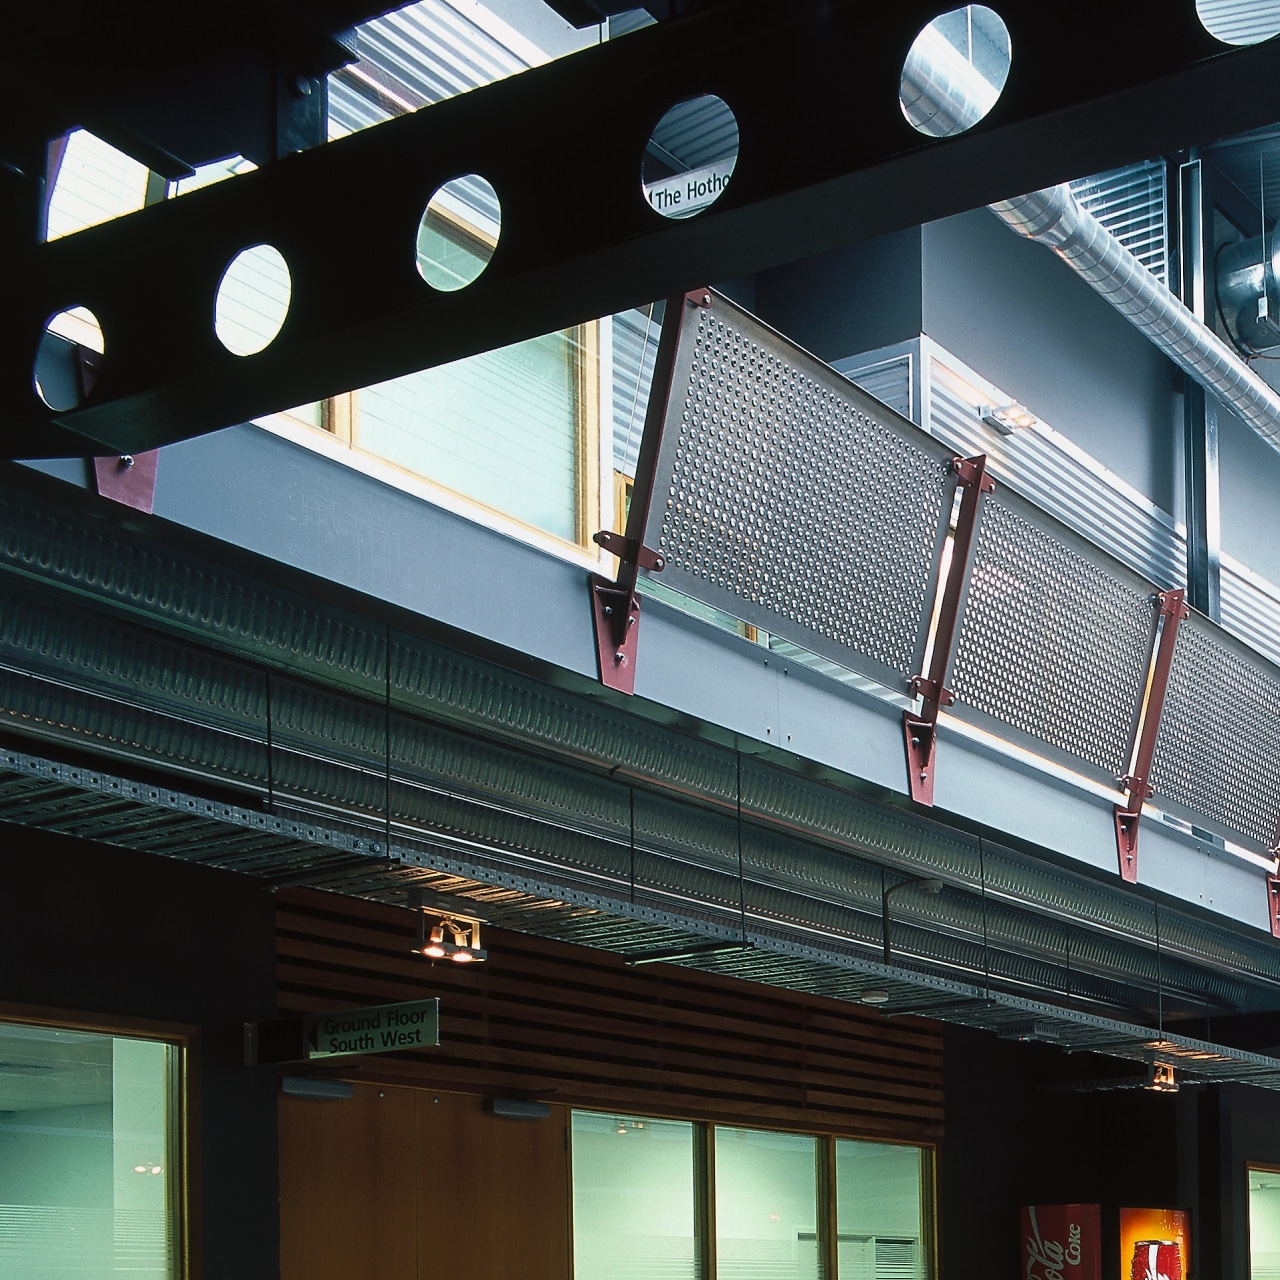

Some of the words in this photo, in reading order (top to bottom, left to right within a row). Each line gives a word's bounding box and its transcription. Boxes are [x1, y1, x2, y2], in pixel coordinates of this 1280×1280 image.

[656, 188, 681, 209] The
[325, 1011, 381, 1035] Ground
[387, 1009, 427, 1027] Floor
[329, 1033, 375, 1054] South
[381, 1028, 422, 1048] West
[1066, 1223, 1081, 1266] Coke
